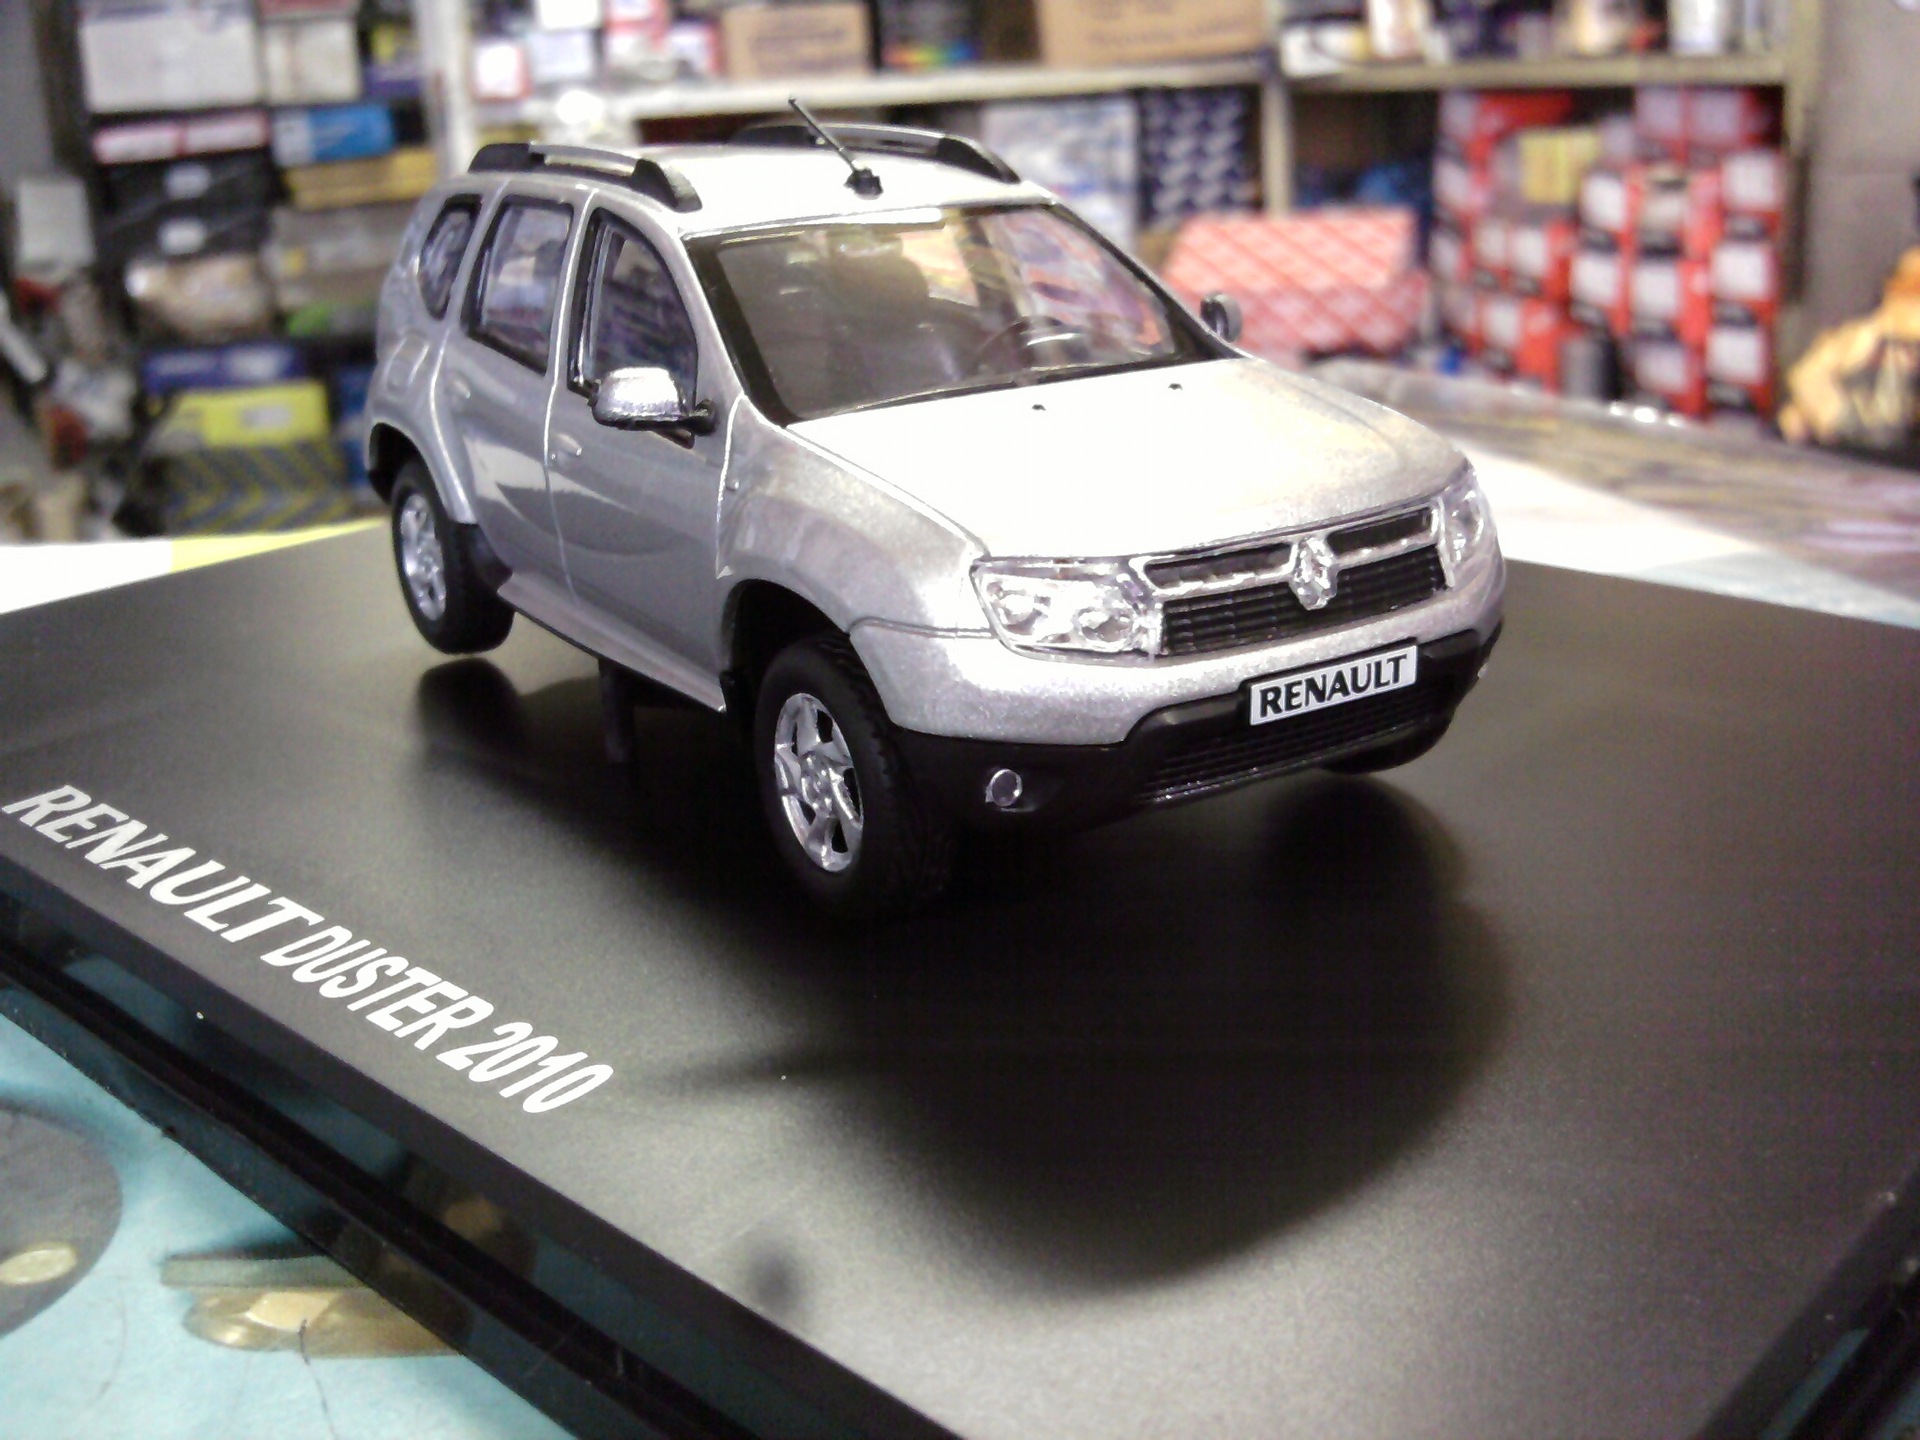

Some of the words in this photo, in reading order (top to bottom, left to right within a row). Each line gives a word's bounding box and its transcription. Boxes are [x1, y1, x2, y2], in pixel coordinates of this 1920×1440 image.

[1259, 654, 1408, 718] RENAULT
[2, 785, 325, 943] RENAULT
[260, 925, 495, 1051] DUSTER
[436, 1021, 614, 1114] 2010
